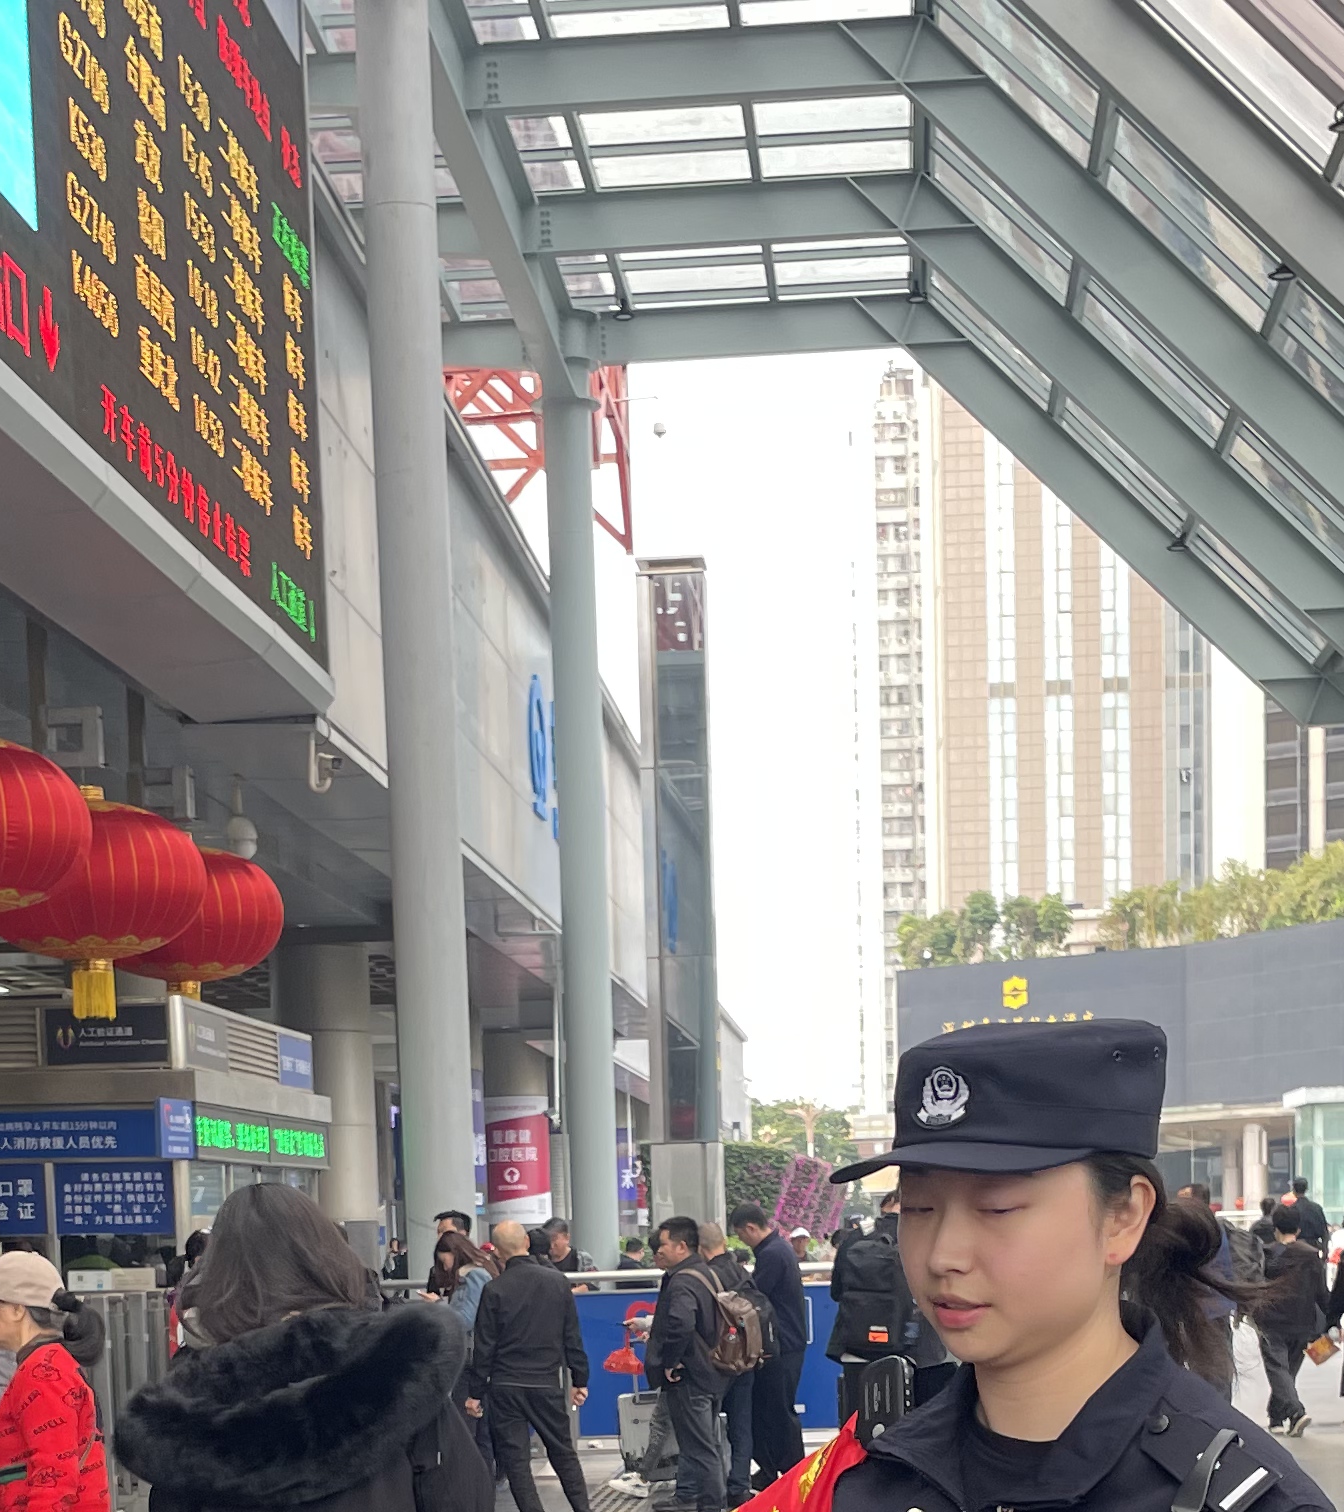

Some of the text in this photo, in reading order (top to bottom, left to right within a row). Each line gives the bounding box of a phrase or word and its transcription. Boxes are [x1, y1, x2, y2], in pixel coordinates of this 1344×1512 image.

[135, 253, 175, 340] 南昌西
[137, 324, 179, 410] 重庆北
[101, 384, 252, 577] 开车前5分钟停止检票
[489, 1147, 538, 1162] 口腔医院
